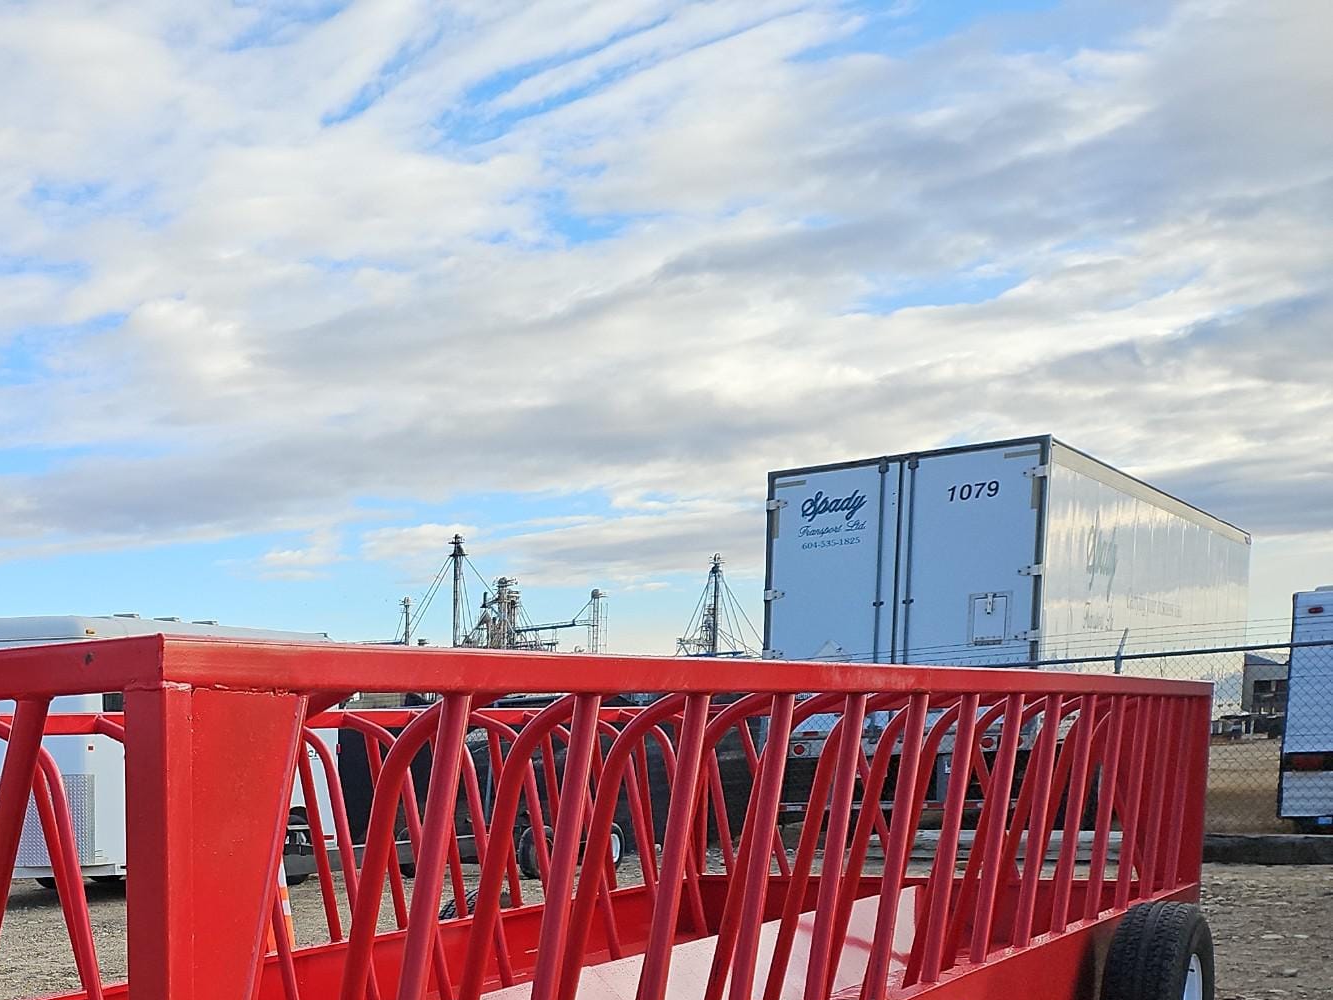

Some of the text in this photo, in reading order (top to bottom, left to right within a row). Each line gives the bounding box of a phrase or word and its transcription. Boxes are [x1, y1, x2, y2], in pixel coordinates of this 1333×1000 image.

[947, 480, 1000, 502] 1079
[801, 489, 868, 522] Spady
[798, 524, 843, 538] Transport
